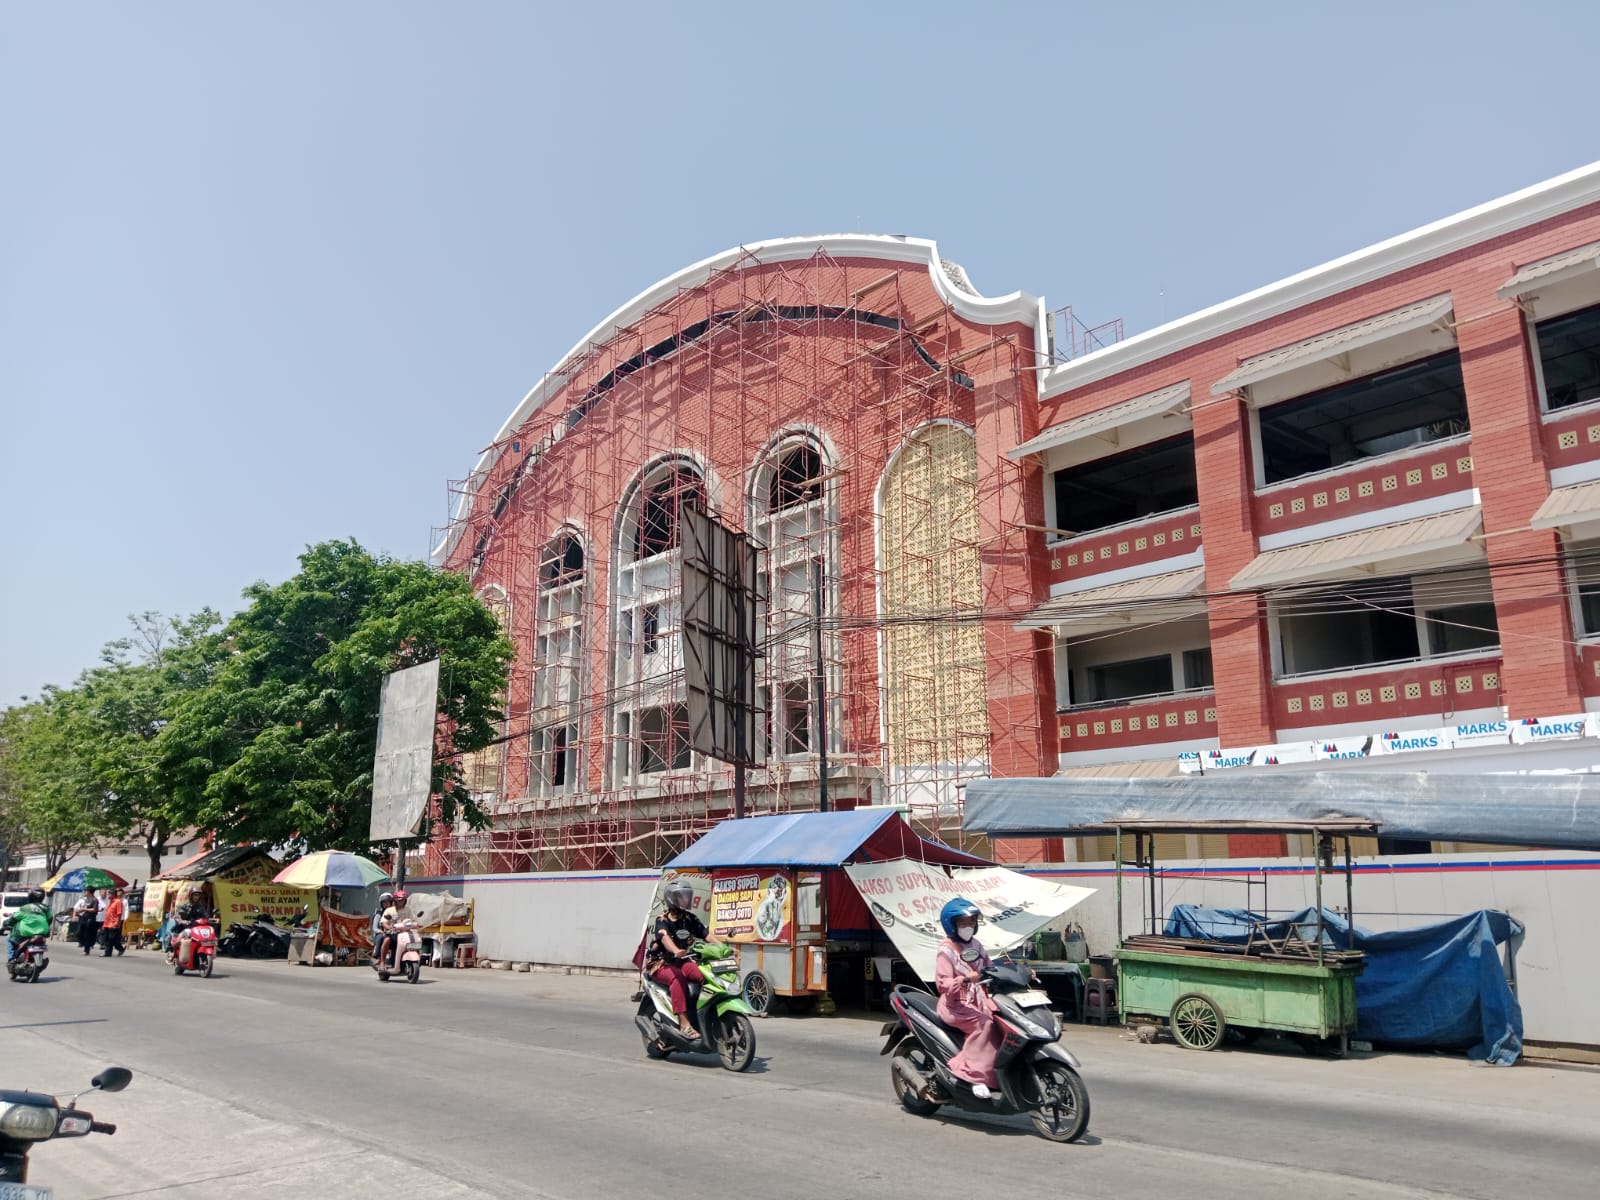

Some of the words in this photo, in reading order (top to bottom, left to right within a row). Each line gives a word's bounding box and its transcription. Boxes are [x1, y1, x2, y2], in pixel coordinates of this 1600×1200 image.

[1457, 720, 1508, 736] MARKS
[1530, 721, 1582, 737] MARKS
[1391, 736, 1438, 751] MARKS
[714, 879, 737, 893] BAKSO
[737, 876, 758, 890] SUPER
[260, 896, 276, 904] MIE
[277, 896, 300, 904] AYAM
[898, 902, 913, 918] &
